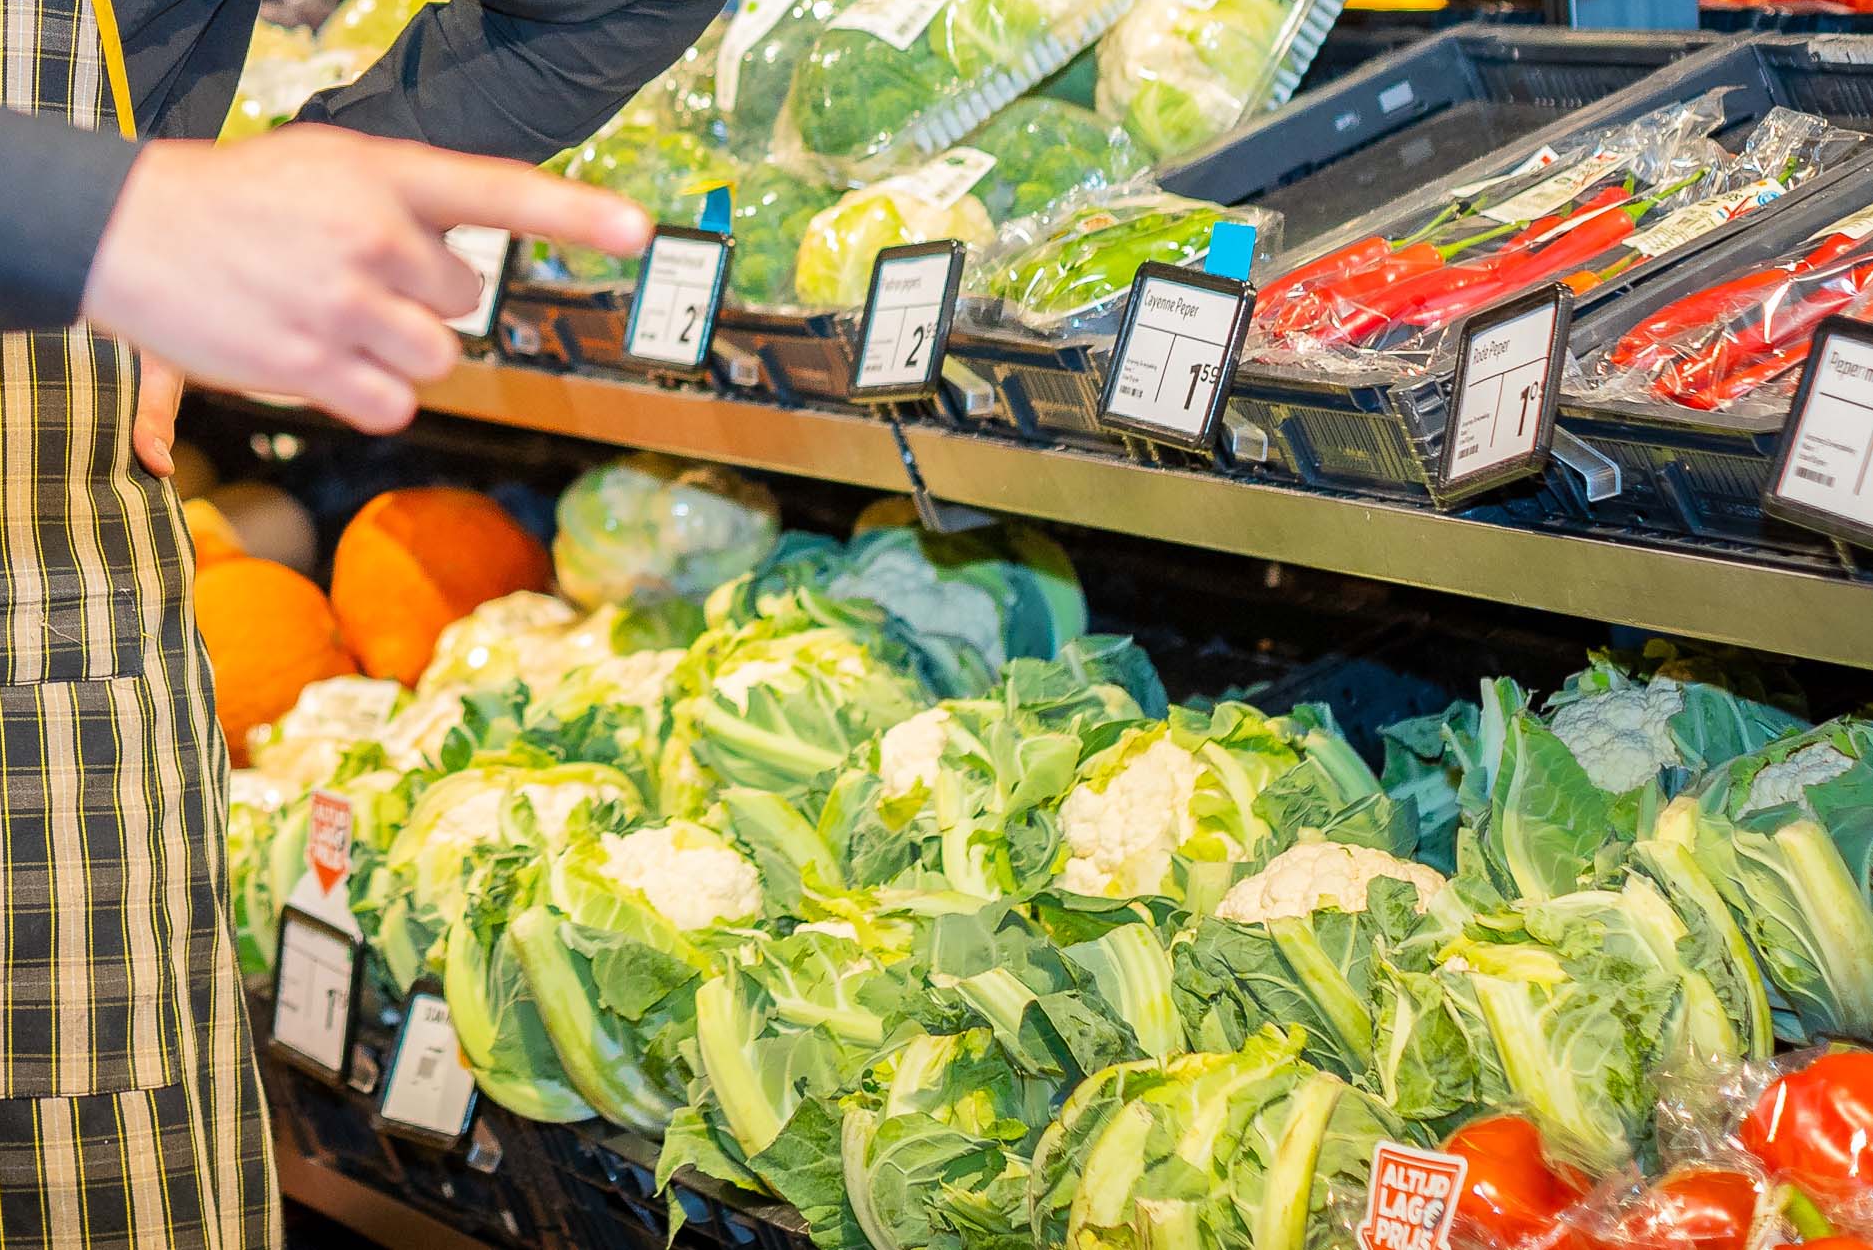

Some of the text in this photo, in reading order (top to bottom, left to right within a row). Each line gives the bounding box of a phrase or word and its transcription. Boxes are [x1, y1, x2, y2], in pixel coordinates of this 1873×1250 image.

[1144, 288, 1200, 321] Cayenne Peper
[1472, 338, 1511, 365] Rode Peper
